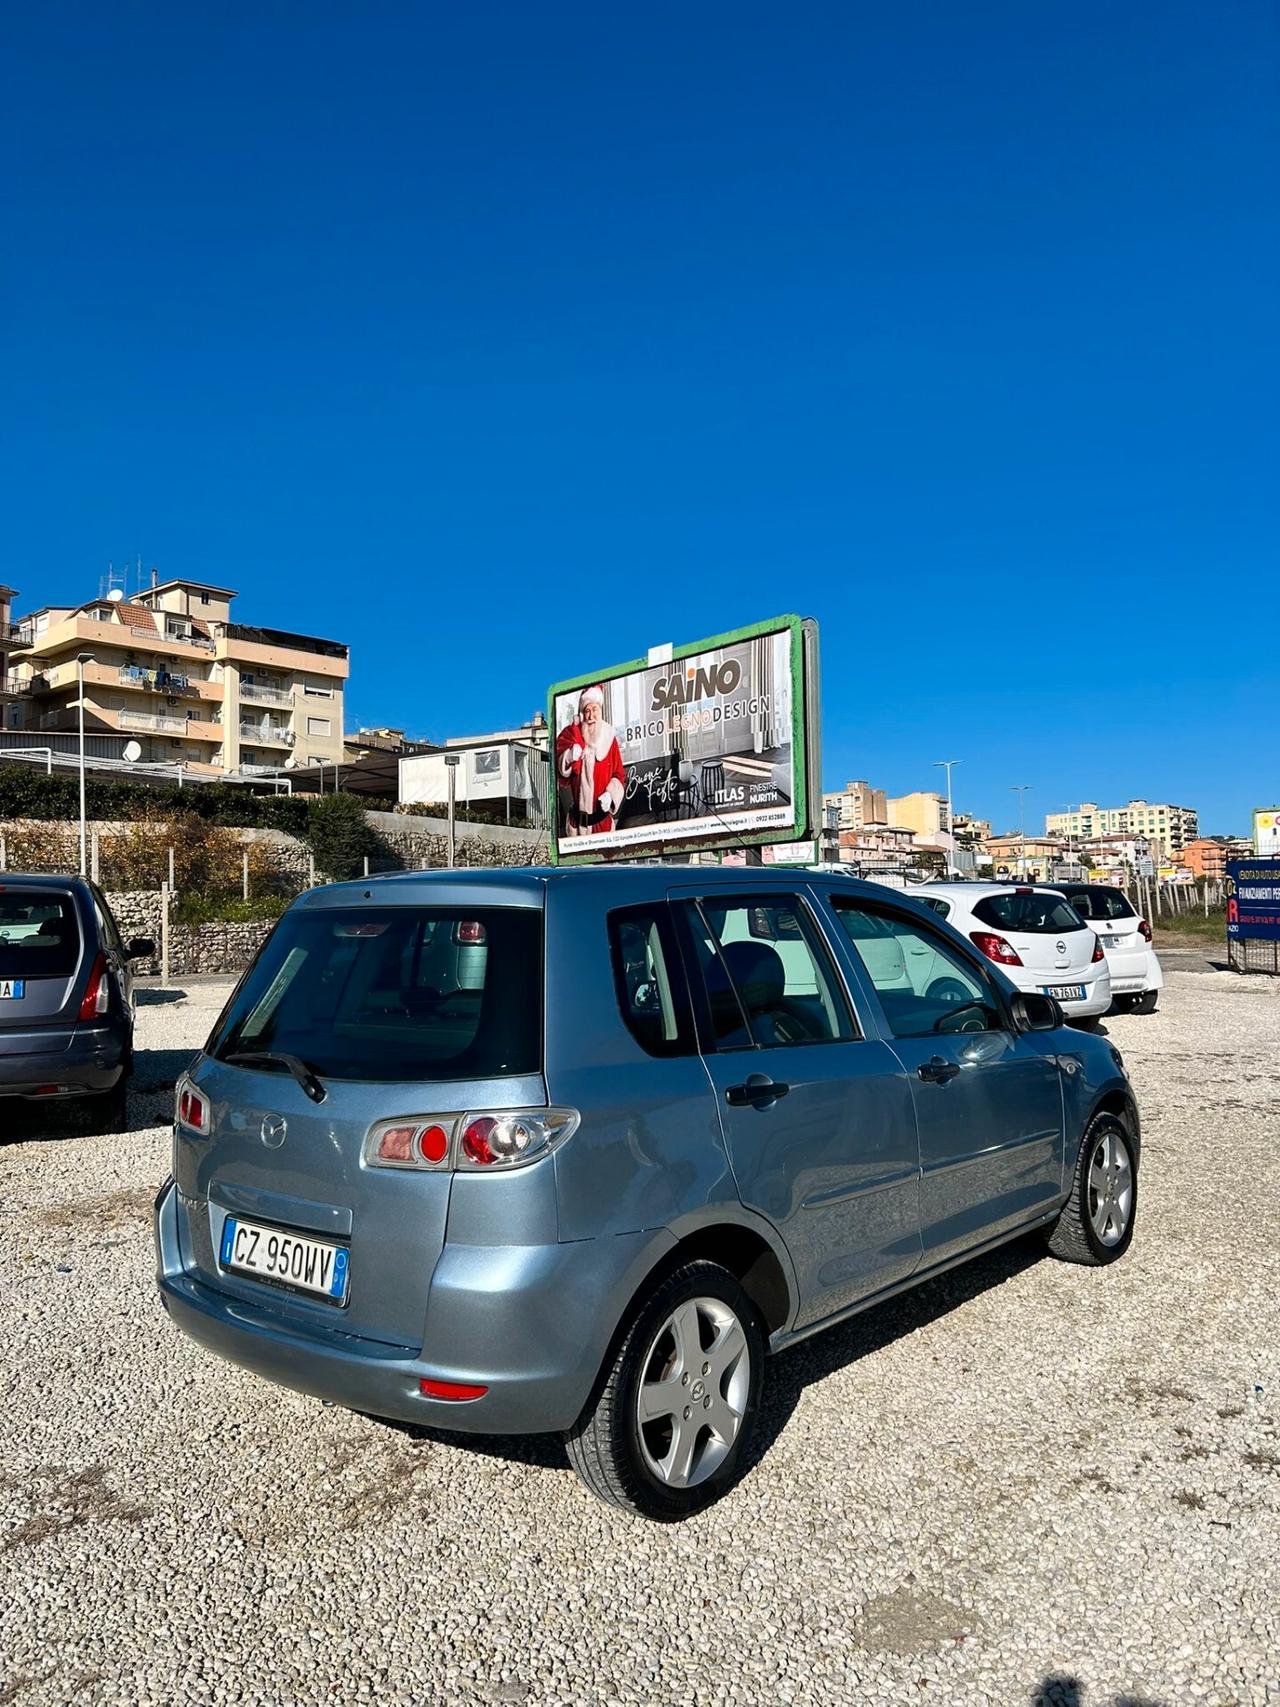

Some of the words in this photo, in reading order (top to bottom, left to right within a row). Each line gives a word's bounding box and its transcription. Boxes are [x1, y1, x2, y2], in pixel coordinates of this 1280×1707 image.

[625, 765, 663, 800] Buone
[643, 769, 678, 811] Feste
[715, 786, 745, 804] ITLAS
[750, 781, 778, 793] FINESTRE
[750, 792, 778, 804] NURITH
[235, 1227, 261, 1267] CZ
